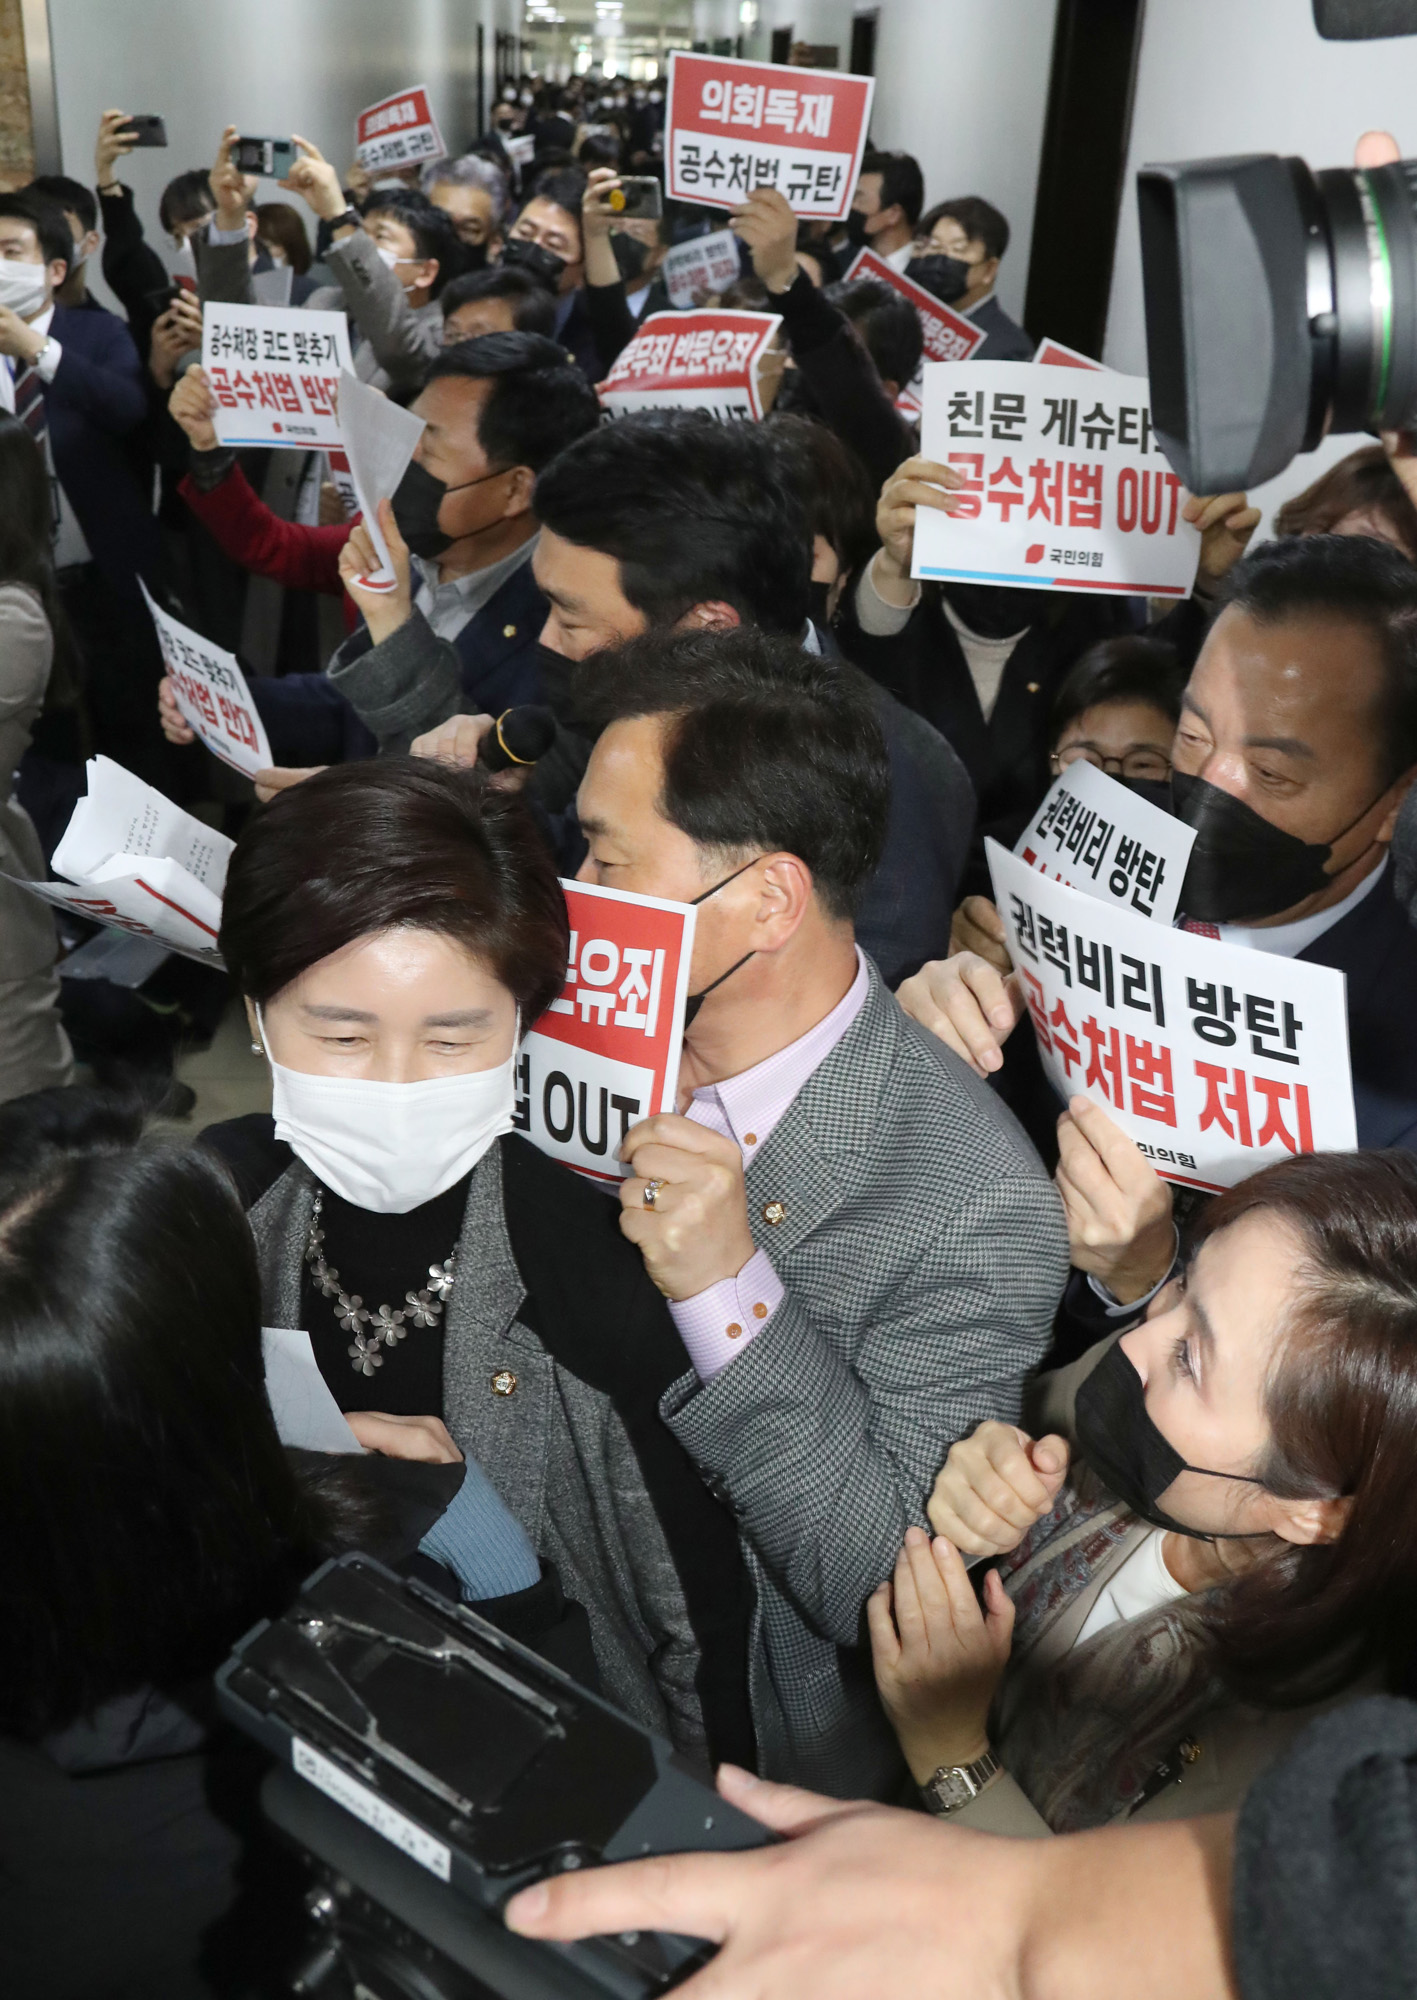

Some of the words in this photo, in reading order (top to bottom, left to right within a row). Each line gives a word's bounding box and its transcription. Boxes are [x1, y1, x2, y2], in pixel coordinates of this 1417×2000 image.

[699, 79, 834, 138] 의회독재
[680, 144, 780, 193] 공수처법
[787, 163, 842, 202] 규탄
[211, 324, 258, 361] 공수처장
[263, 330, 291, 362] 코드
[293, 332, 340, 368] 맞추기
[668, 328, 759, 378] 반문유죄
[211, 366, 304, 414] 공수처법
[947, 390, 1027, 441] 친문
[1041, 397, 1164, 455] 게슈타
[946, 452, 1104, 530] 공수처법
[1116, 467, 1183, 536] OUT
[1050, 548, 1104, 568] 국민의힘
[216, 692, 260, 754] 반대
[1036, 787, 1116, 880] 권력비리
[1109, 834, 1166, 918] 방탄
[1009, 890, 1167, 1029] 권력비리
[1185, 976, 1303, 1065] 방탄
[1020, 964, 1178, 1129] 공수처법
[1194, 1059, 1315, 1155] 저지
[543, 1070, 640, 1157] OUT
[1139, 1140, 1198, 1171] 민의힘
